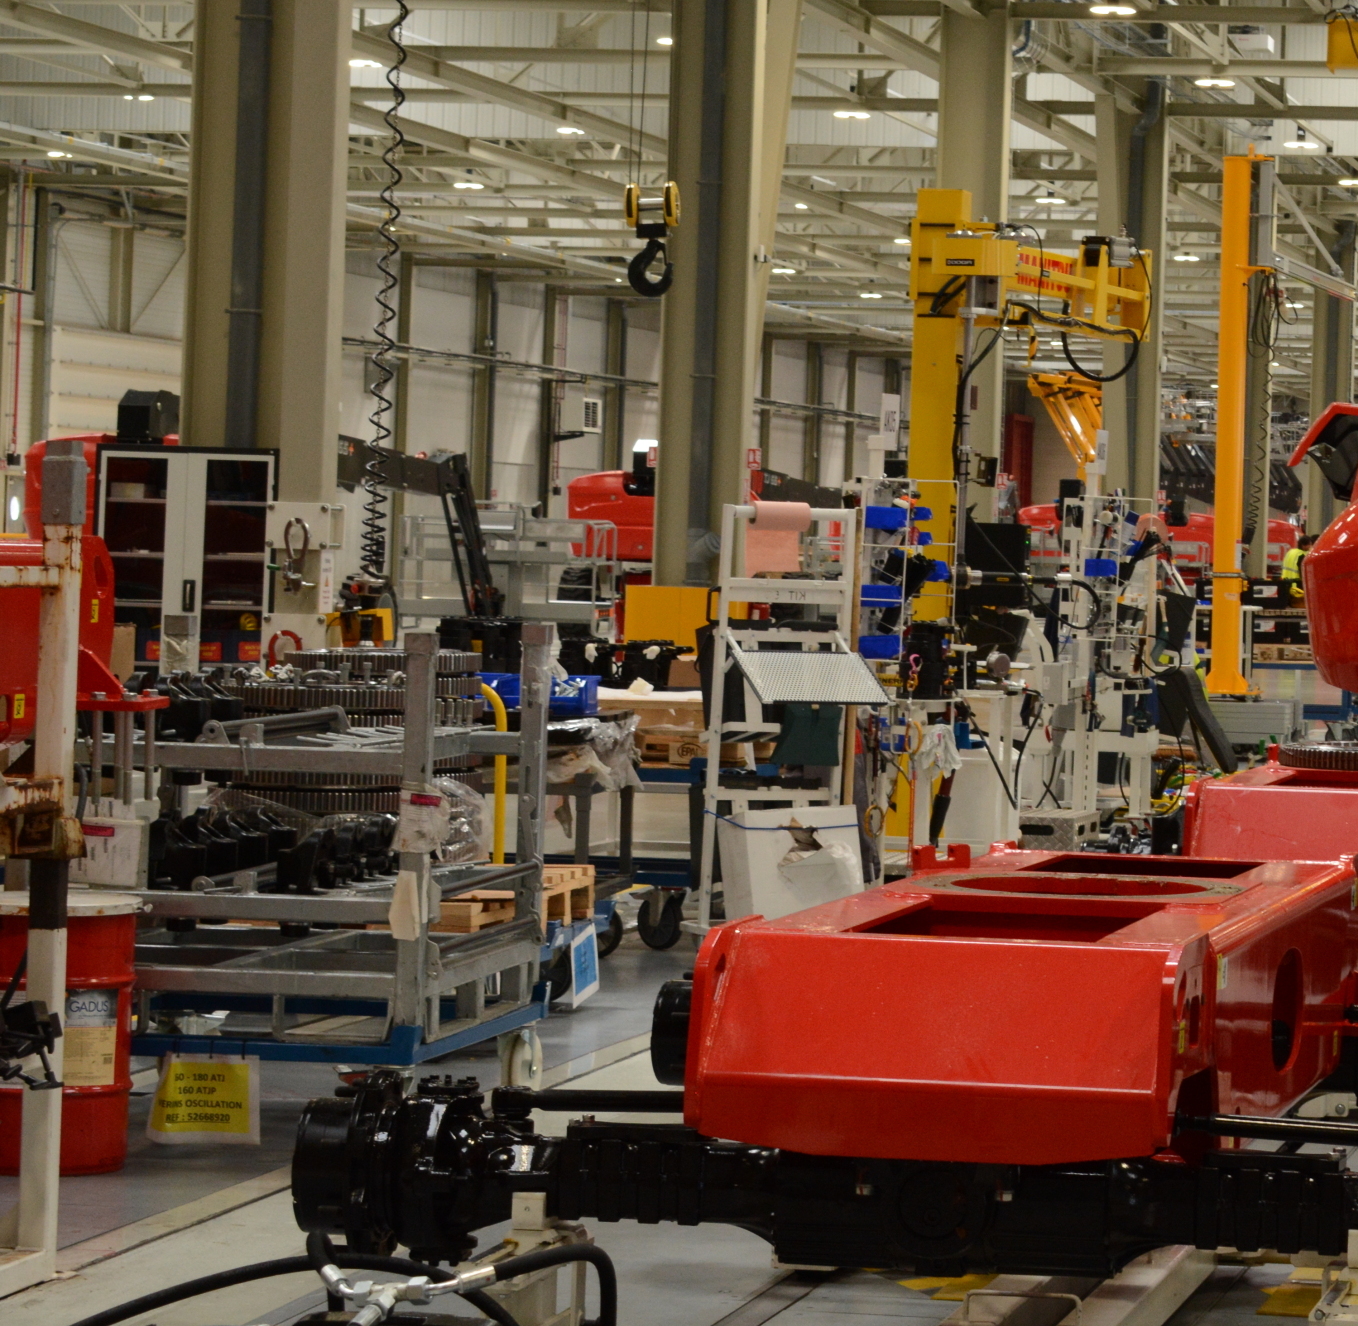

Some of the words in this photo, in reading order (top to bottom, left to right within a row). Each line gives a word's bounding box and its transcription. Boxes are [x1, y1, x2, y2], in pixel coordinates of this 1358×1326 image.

[69, 1000, 109, 1013] GADUS
[192, 1073, 209, 1082] 180
[178, 1086, 194, 1095] 160
[185, 1099, 243, 1109] OSCILLATION
